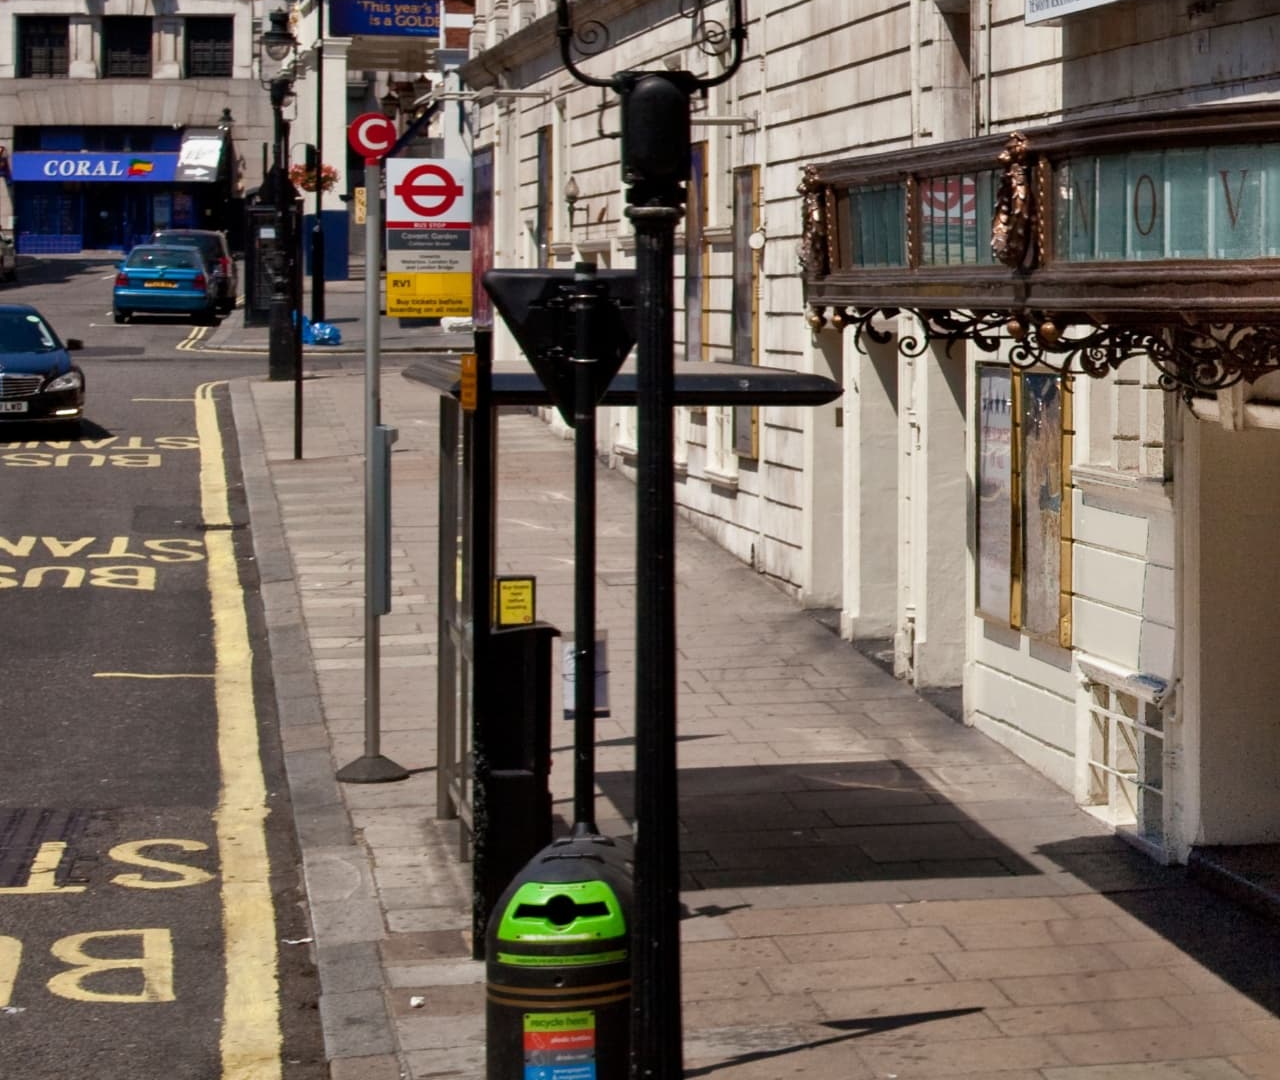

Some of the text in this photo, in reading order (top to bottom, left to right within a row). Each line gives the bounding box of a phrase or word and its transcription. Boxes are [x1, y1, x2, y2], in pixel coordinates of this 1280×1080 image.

[384, 18, 393, 27] a
[358, 118, 388, 150] C
[44, 160, 124, 176] CORAL
[392, 280, 411, 288] RV1
[0, 436, 200, 450] STAN
[2, 453, 161, 467] BUS
